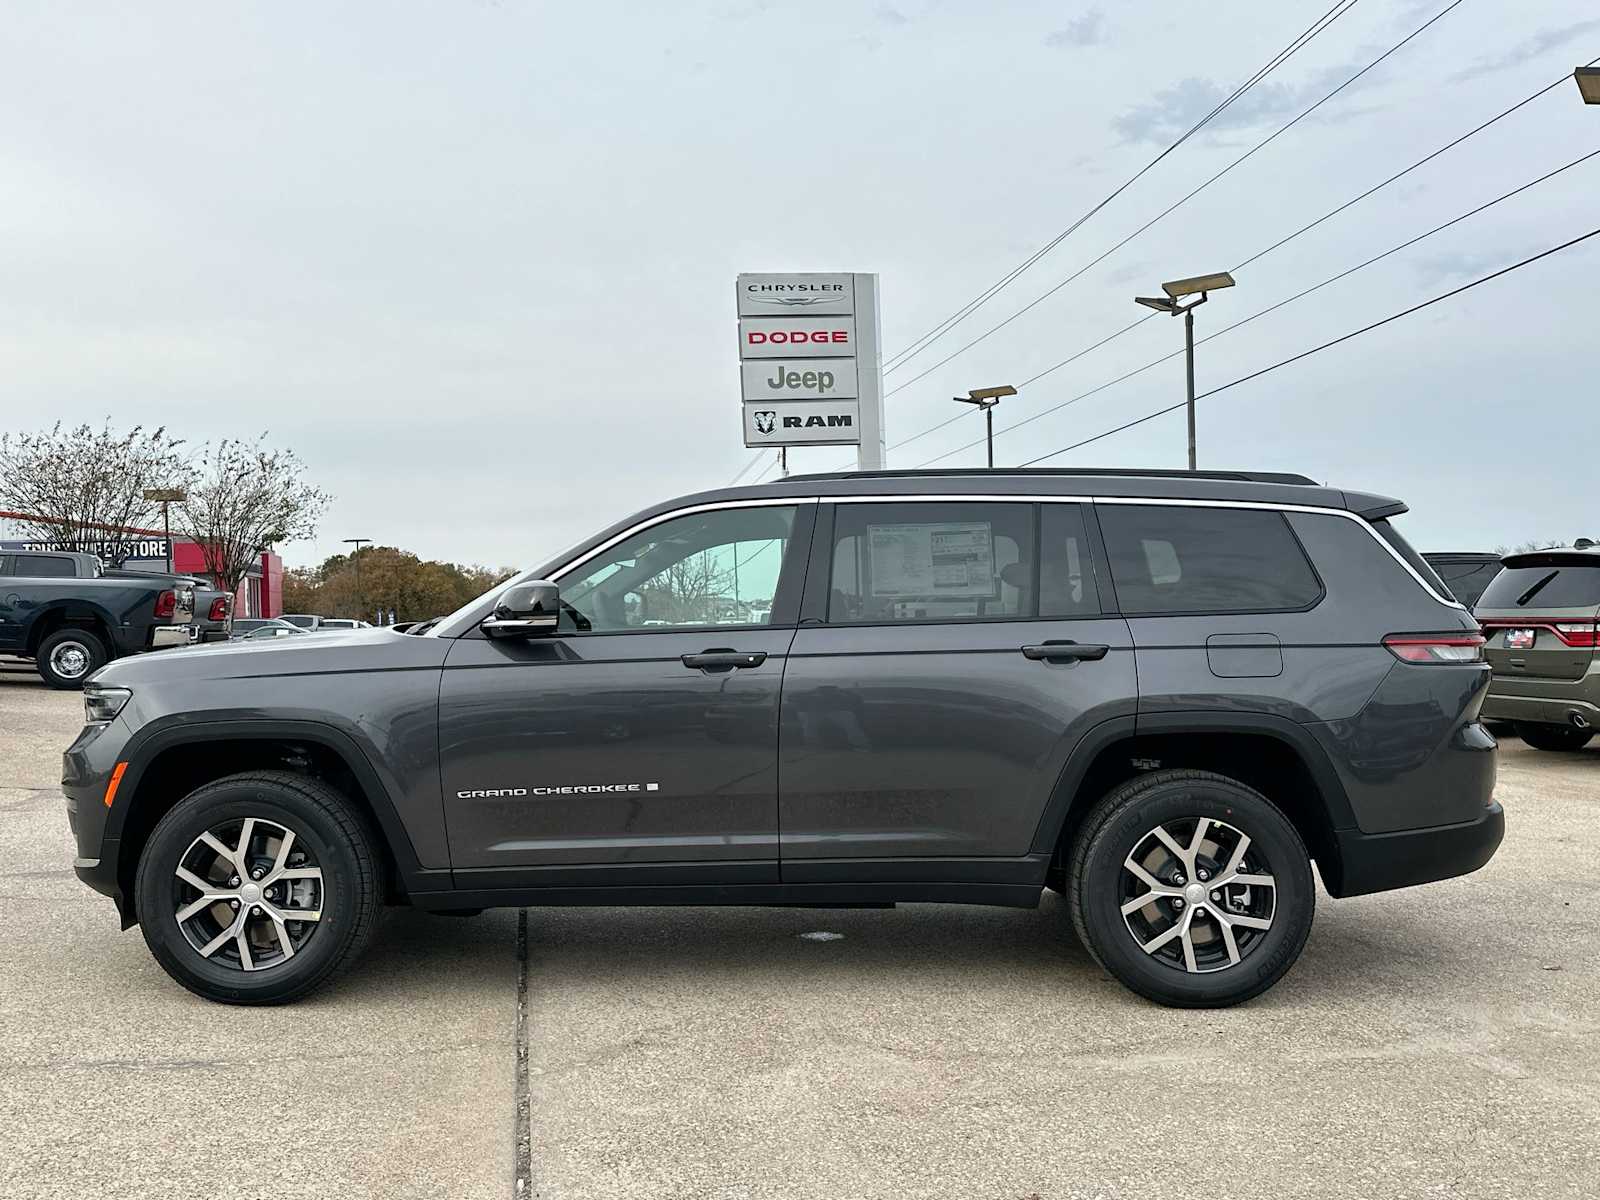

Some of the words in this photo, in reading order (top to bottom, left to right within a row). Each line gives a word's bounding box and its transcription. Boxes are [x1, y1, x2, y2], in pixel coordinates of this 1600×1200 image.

[747, 284, 844, 292] CHRYSLER
[748, 331, 849, 344] DODGE
[767, 366, 835, 393] Jeep
[783, 415, 852, 428] RAM
[123, 540, 167, 557] STORE
[456, 788, 527, 799] GRAND
[533, 784, 641, 795] CHEROKEE
